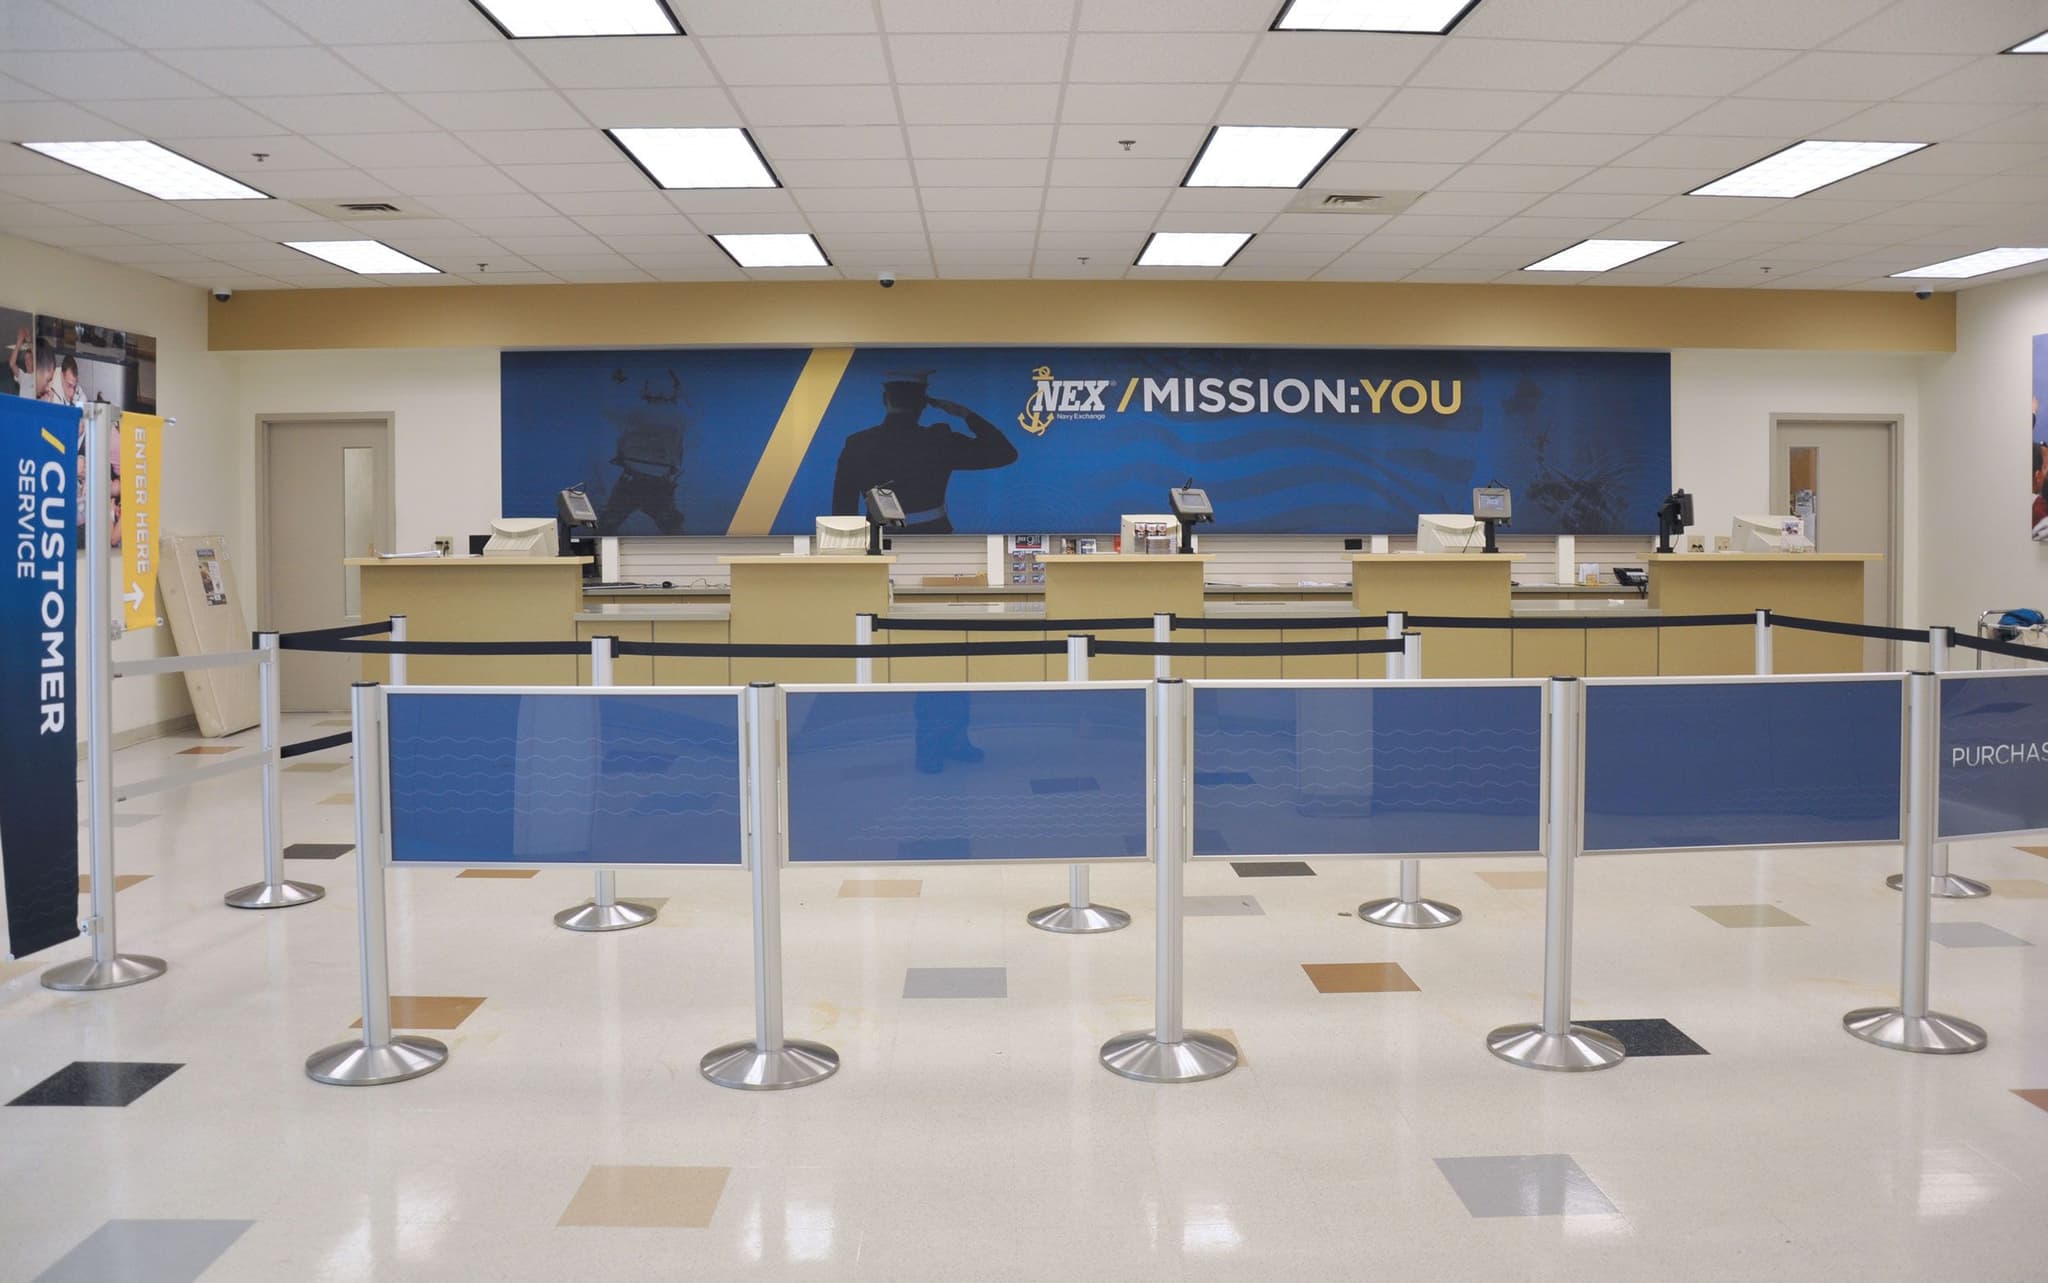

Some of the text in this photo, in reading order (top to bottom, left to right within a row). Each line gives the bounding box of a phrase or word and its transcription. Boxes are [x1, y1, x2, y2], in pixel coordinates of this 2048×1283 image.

[1057, 413, 1105, 421] Navy Exchange
[17, 459, 36, 579] SERVICE
[134, 428, 149, 574] ENTER HERE
